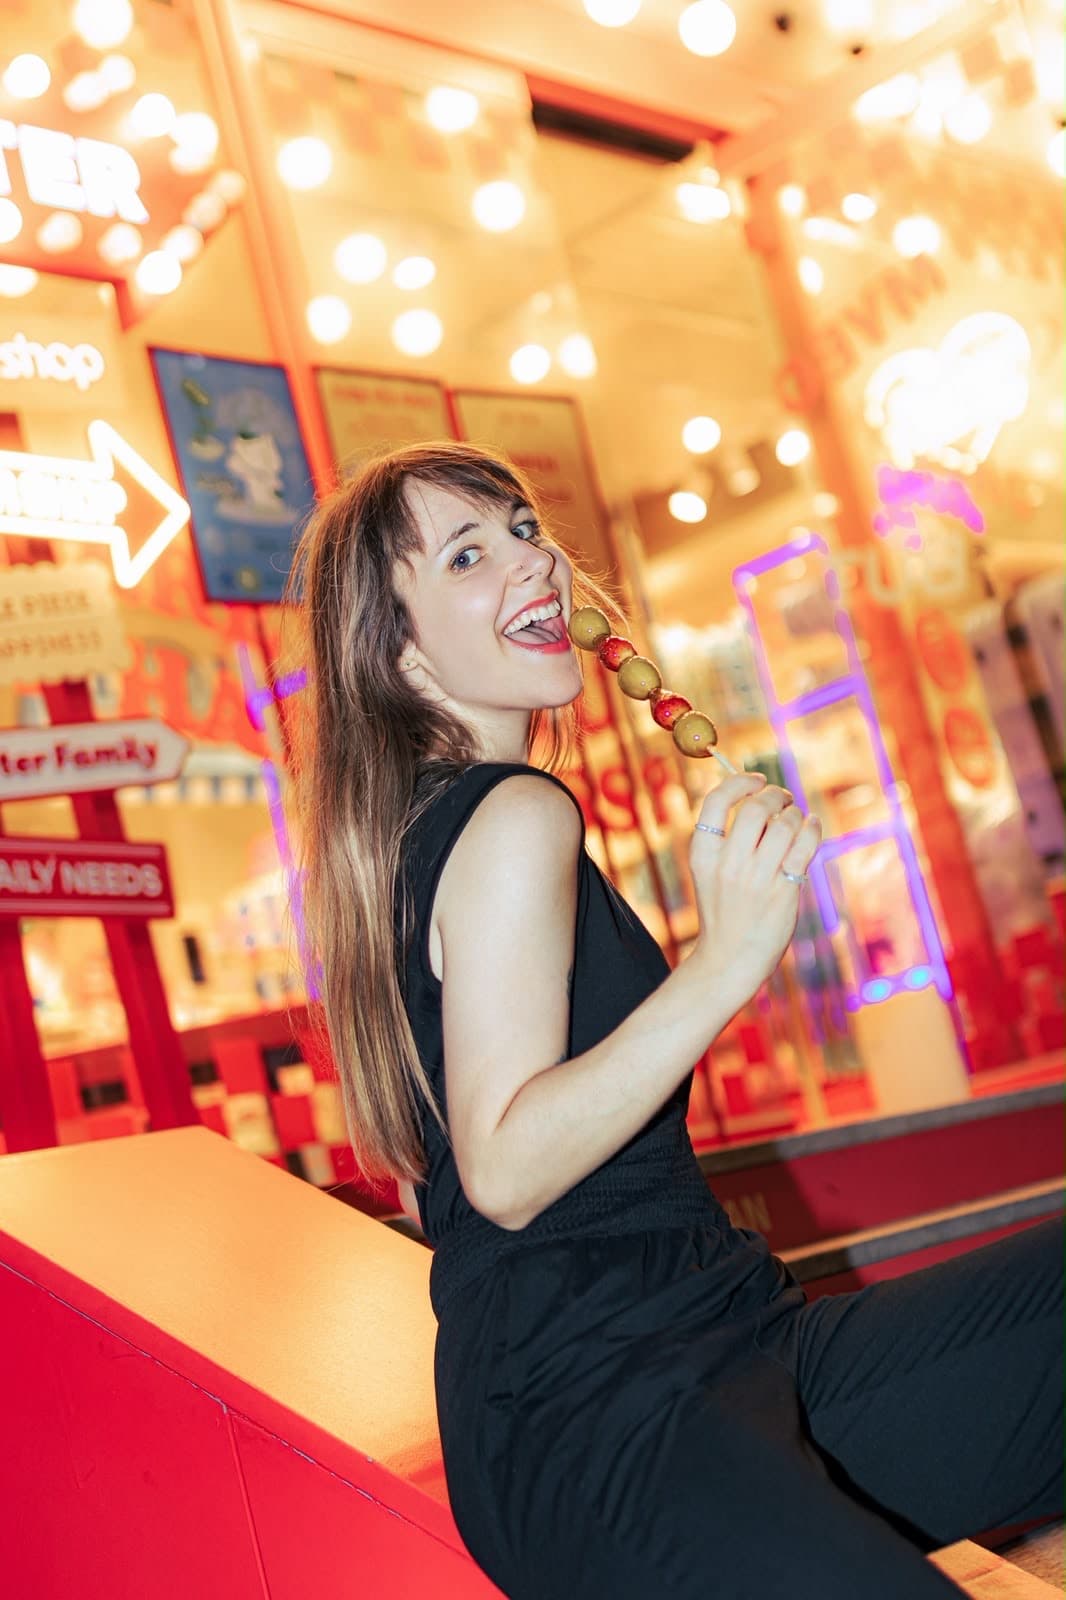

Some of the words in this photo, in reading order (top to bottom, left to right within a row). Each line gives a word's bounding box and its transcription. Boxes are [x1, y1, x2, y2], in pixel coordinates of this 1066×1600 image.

[0, 331, 104, 392] shop
[54, 737, 157, 770] Family
[60, 859, 162, 898] NEEDS
